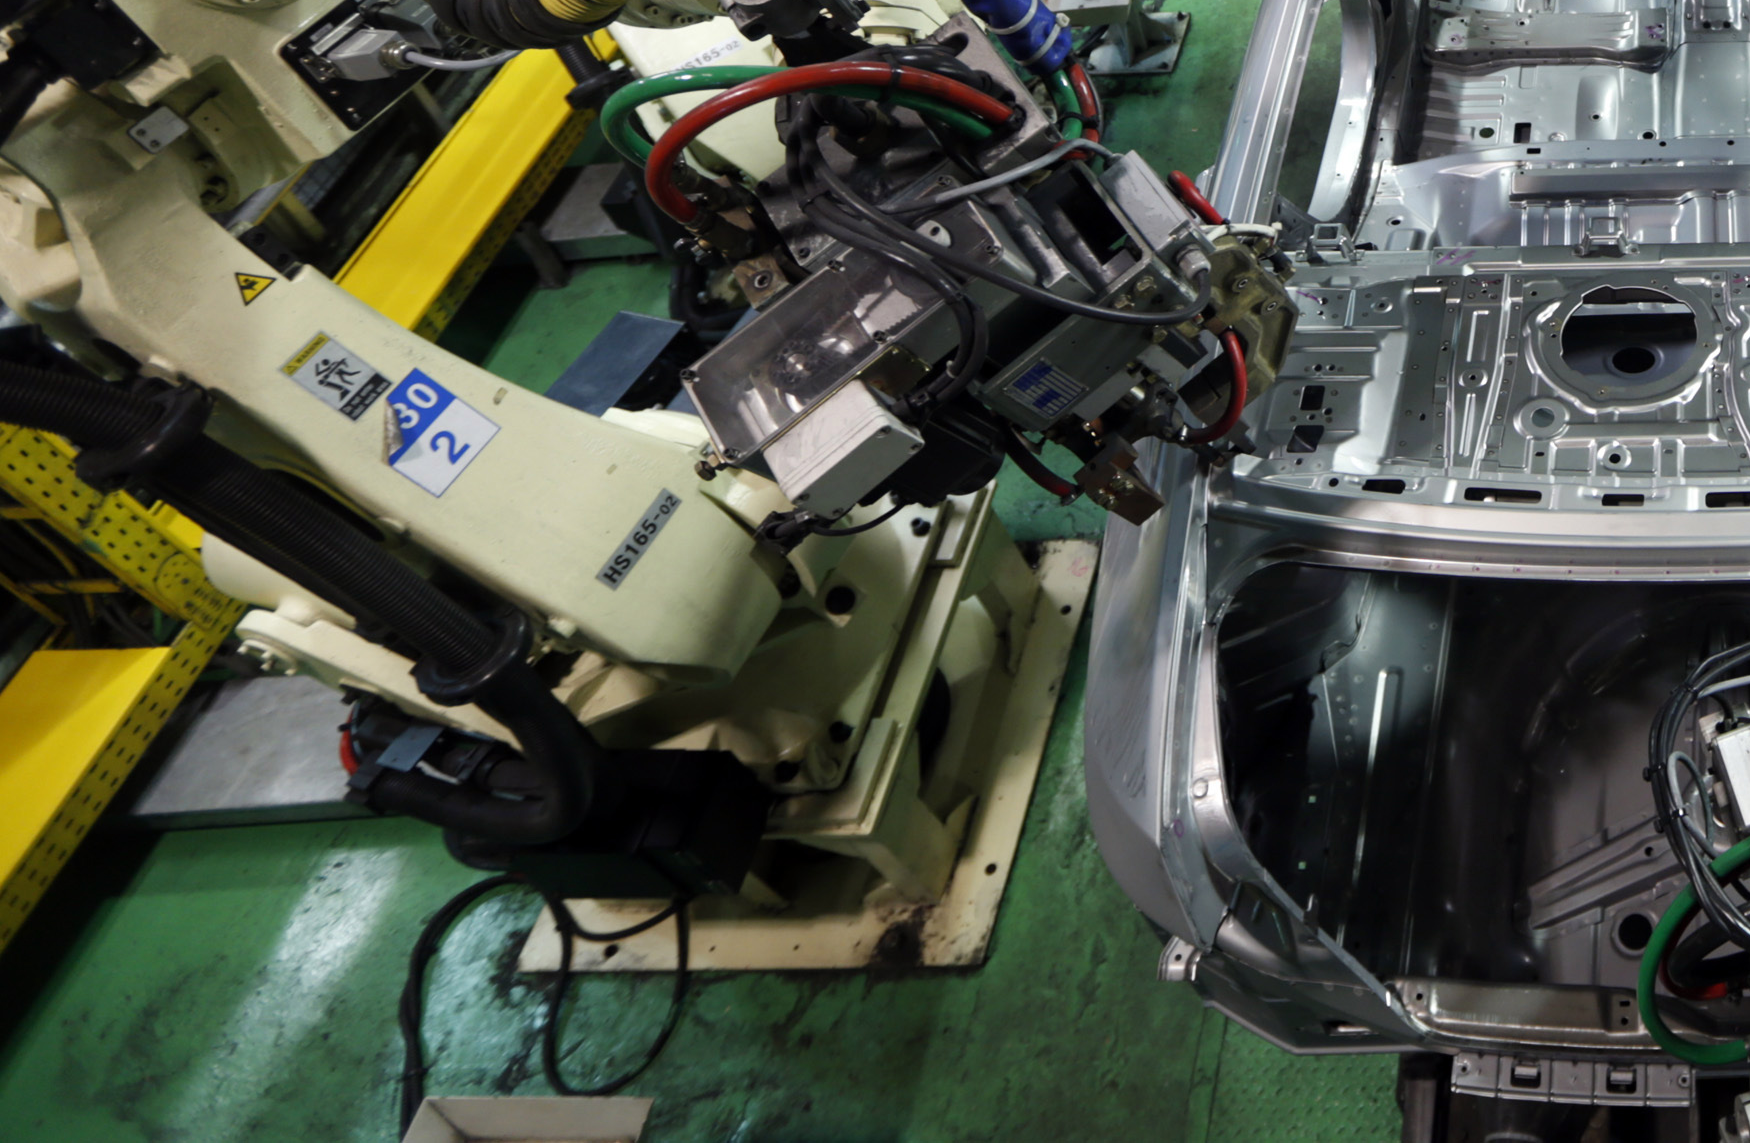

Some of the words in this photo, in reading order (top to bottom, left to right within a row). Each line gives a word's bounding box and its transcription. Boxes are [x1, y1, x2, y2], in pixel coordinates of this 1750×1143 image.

[675, 40, 740, 72] S165-02
[392, 383, 439, 429] 30
[430, 430, 470, 465] 2
[603, 494, 678, 584] HS165-02
